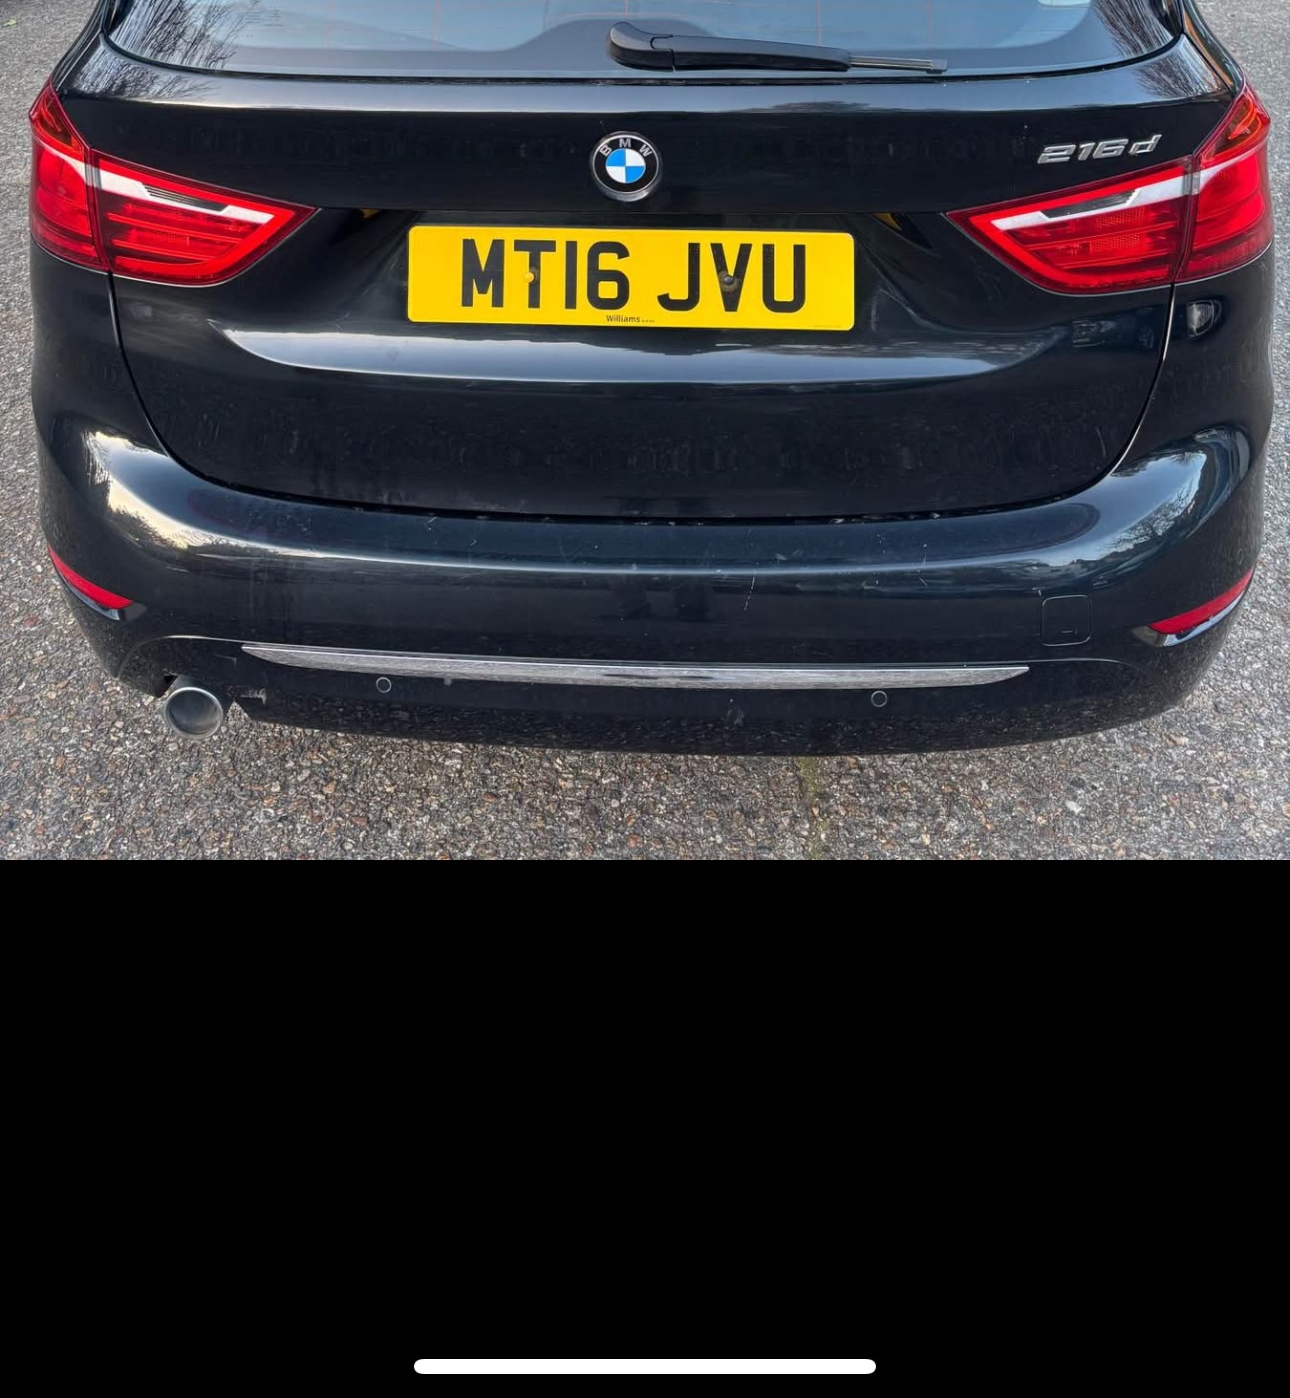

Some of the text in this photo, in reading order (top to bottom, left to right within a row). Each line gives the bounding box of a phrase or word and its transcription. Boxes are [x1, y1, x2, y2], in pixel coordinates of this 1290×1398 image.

[599, 138, 653, 157] BMW
[1037, 134, 1162, 164] 216d
[461, 238, 806, 314] MT16 JVU
[606, 314, 640, 323] Williams
